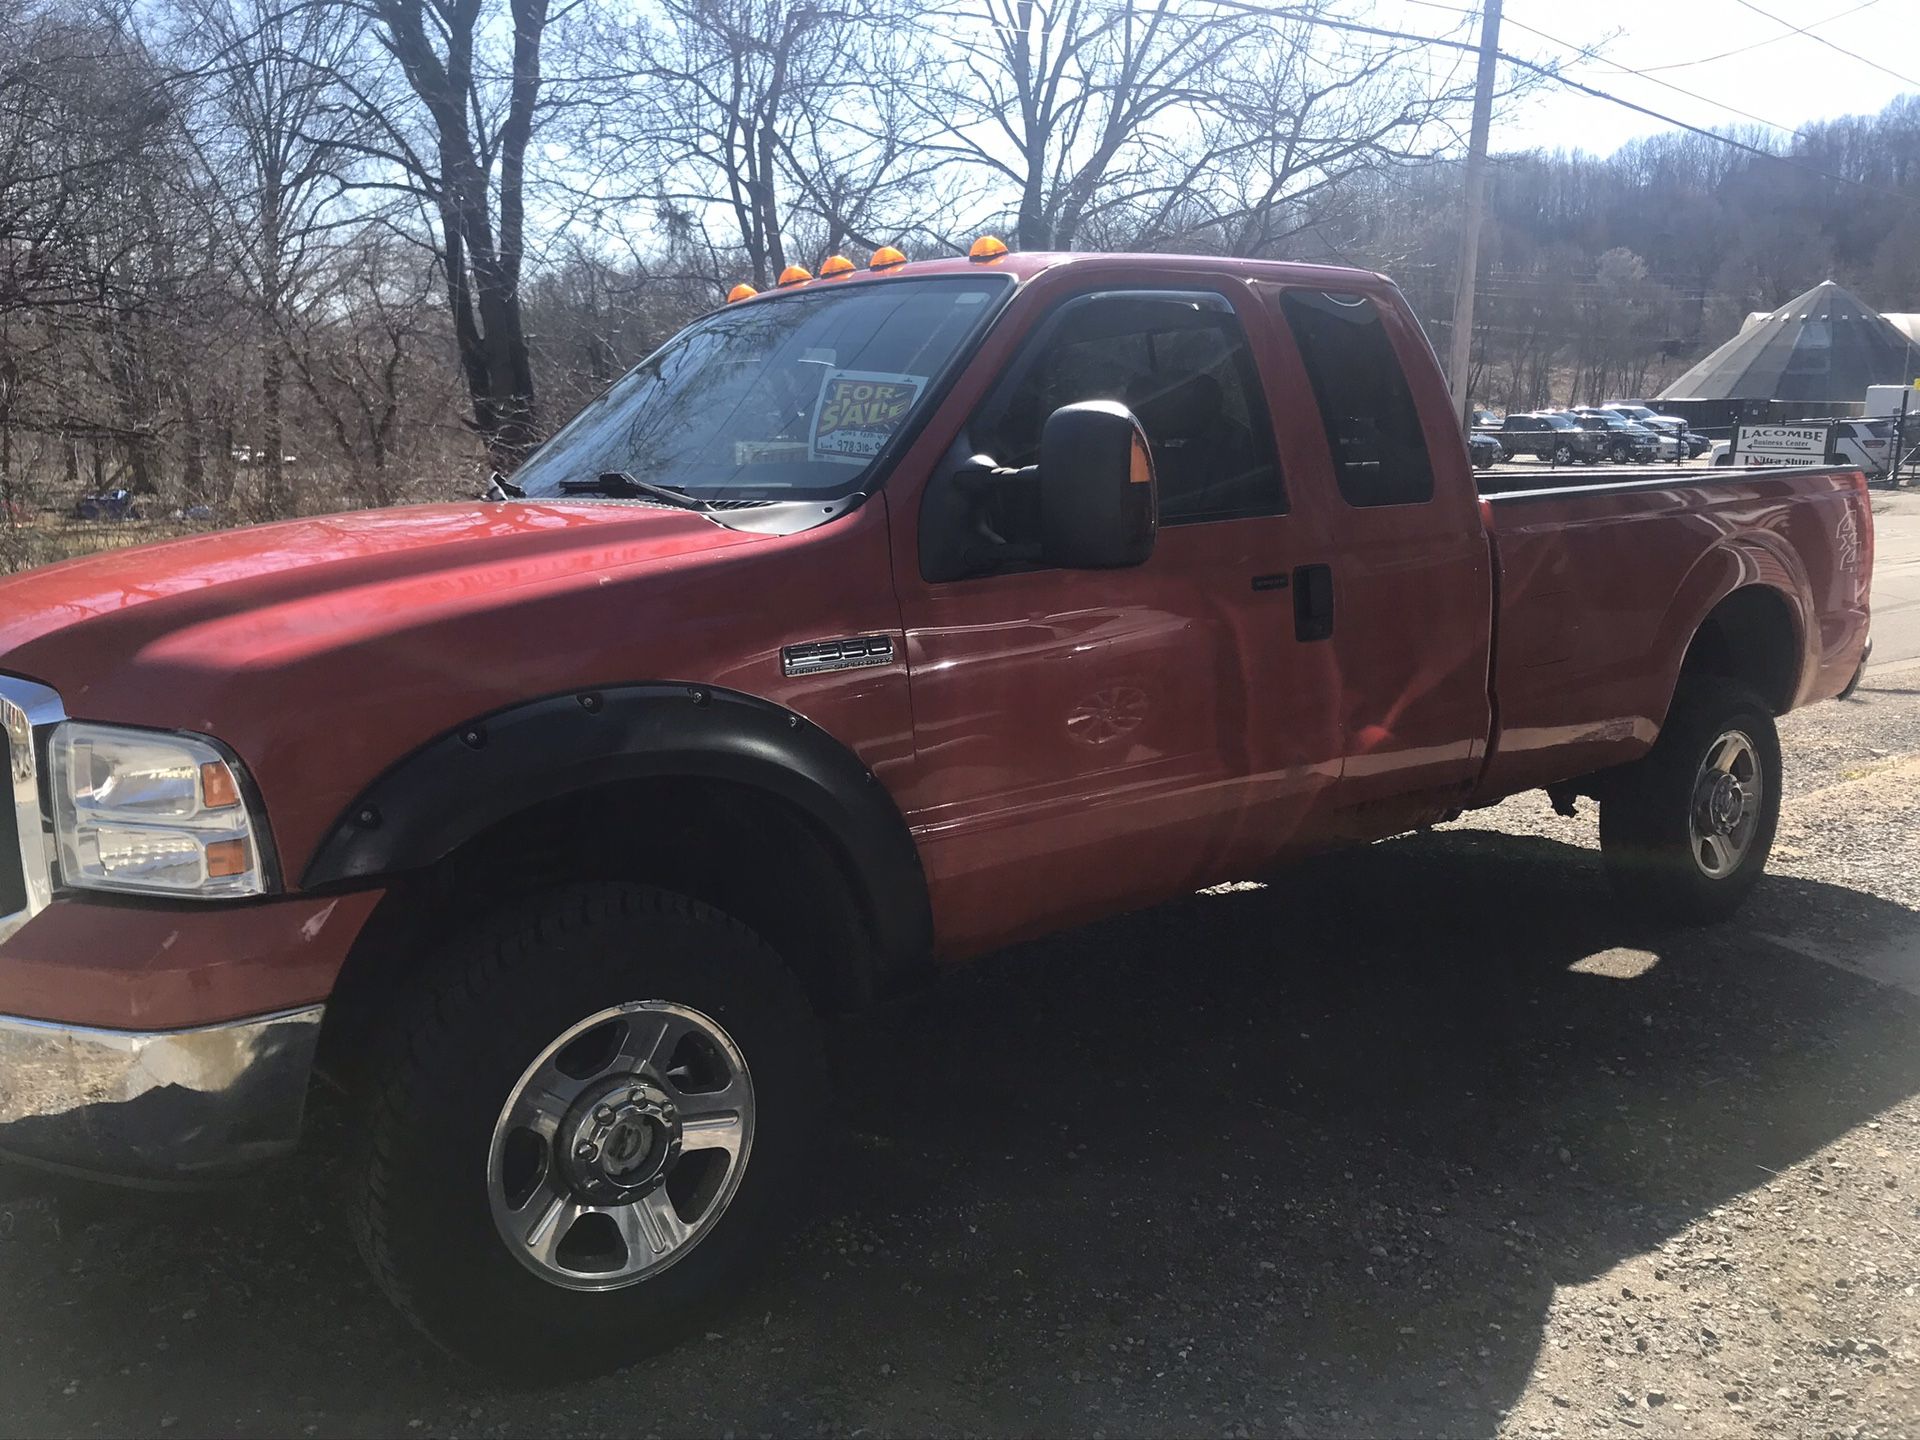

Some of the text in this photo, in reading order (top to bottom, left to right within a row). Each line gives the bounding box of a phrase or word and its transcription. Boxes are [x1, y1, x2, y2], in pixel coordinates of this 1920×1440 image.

[835, 383, 898, 400] FOR
[819, 399, 906, 432] SALE
[1741, 429, 1823, 443] LACOMBE
[1785, 439, 1808, 447] Center
